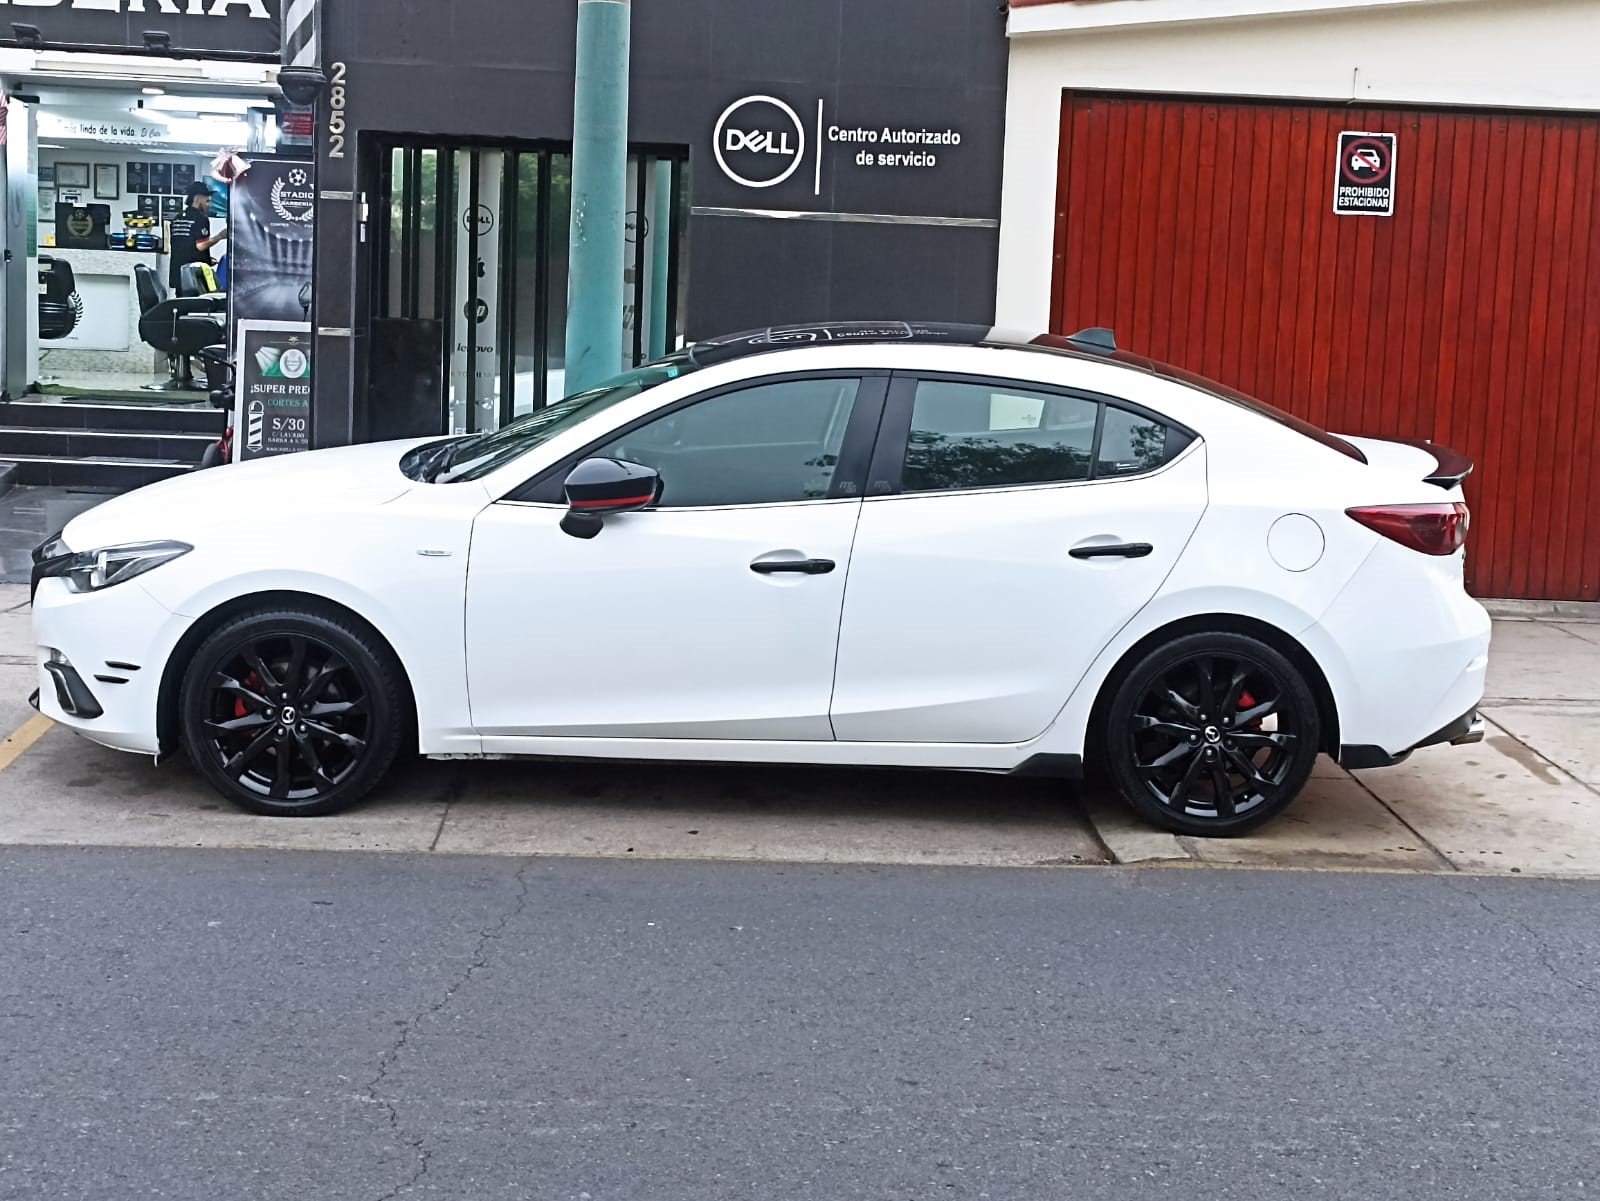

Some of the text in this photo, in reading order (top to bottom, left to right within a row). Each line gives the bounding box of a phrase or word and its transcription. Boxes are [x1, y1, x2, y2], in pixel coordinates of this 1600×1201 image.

[328, 62, 346, 158] 2852
[80, 123, 97, 134] lindo
[99, 124, 108, 134] de
[111, 124, 118, 135] la
[828, 125, 960, 145] Centro Autorizado
[726, 129, 794, 155] DELL
[855, 150, 936, 167] de servicio
[1340, 187, 1389, 197] PROHIBIDO
[1339, 197, 1388, 207] ESTACIONAR
[457, 343, 494, 353] leovo
[288, 385, 310, 394] PRE
[272, 417, 305, 431] S/30
